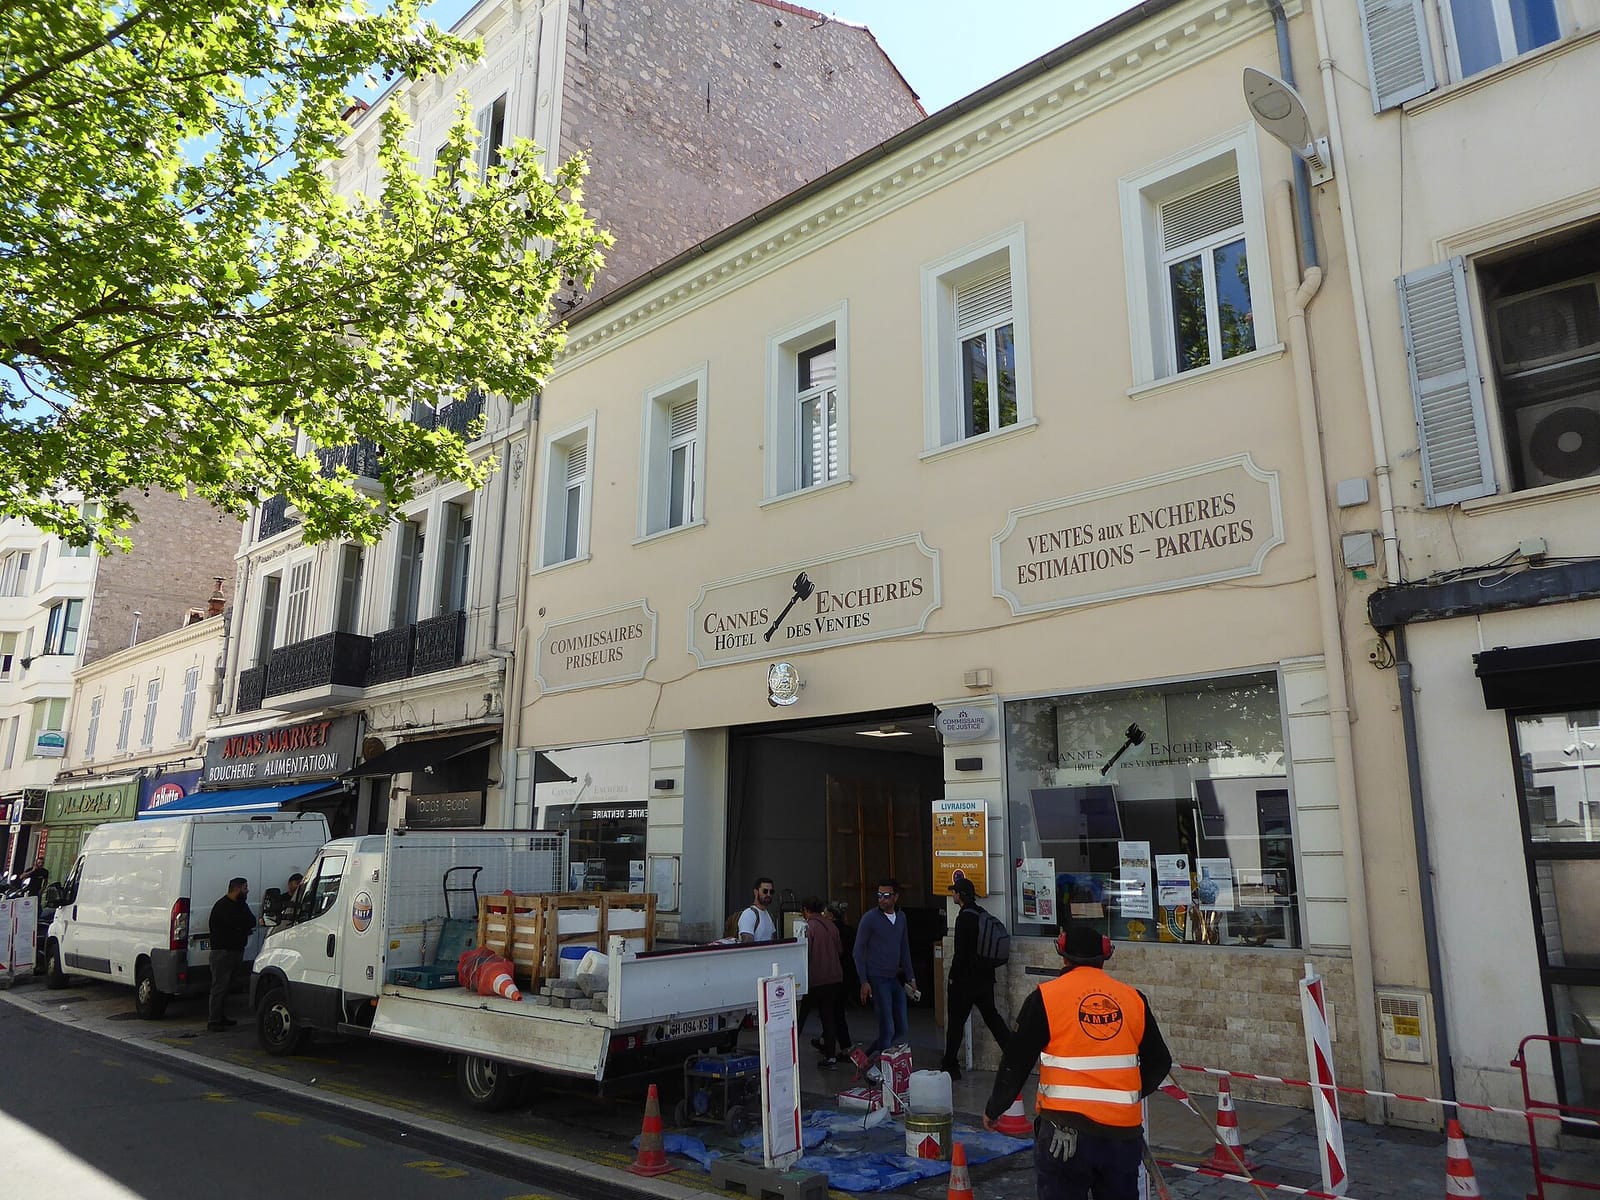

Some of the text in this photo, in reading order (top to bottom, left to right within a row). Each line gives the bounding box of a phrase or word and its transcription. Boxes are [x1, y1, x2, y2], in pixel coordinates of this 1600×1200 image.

[1027, 493, 1236, 556] VENTES aux ENCHERES
[1017, 544, 1134, 584] ESTIMATIONS
[1155, 519, 1254, 559] PARTAGES
[703, 577, 923, 634] CANNES ENCHERES
[550, 624, 643, 655] COMMISSAIRES
[715, 612, 870, 650] HÔTEL DES VENTES
[566, 647, 624, 670] PRISEURS
[222, 721, 332, 759] ATLAS MARKET
[1047, 740, 1232, 763] CANNES ENCHÈRES
[941, 802, 976, 810] LIVRAISON
[1083, 1012, 1118, 1023] AMTP
